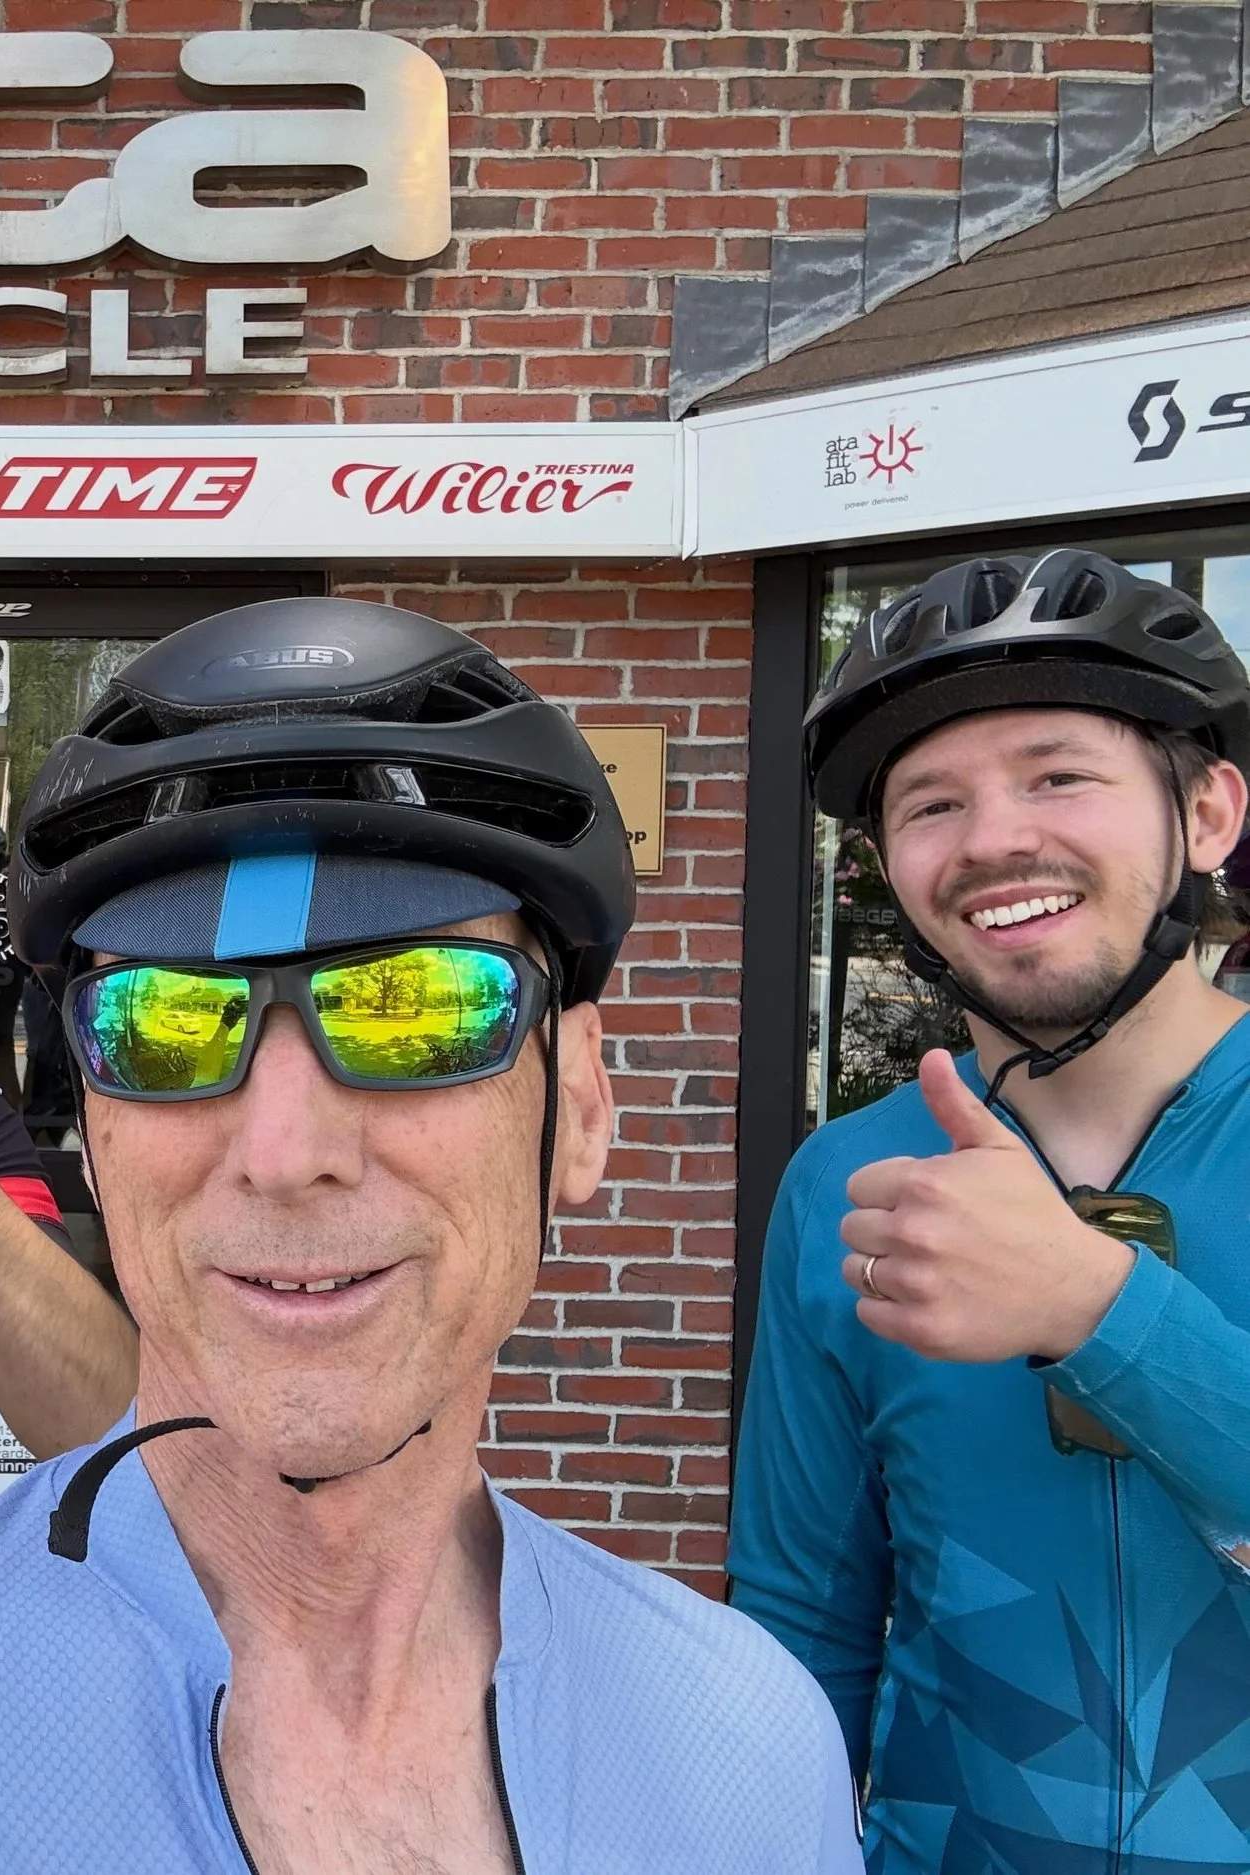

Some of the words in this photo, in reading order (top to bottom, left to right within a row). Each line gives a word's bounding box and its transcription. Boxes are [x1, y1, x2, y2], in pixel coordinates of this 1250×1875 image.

[826, 435, 858, 454] ata
[534, 463, 635, 475] TRIESTINA
[826, 451, 852, 470] fit
[824, 468, 857, 488] lab
[0, 466, 253, 511] TIME
[331, 462, 634, 516] Wilier
[871, 495, 909, 506] delivered
[230, 649, 334, 667] ABUS
